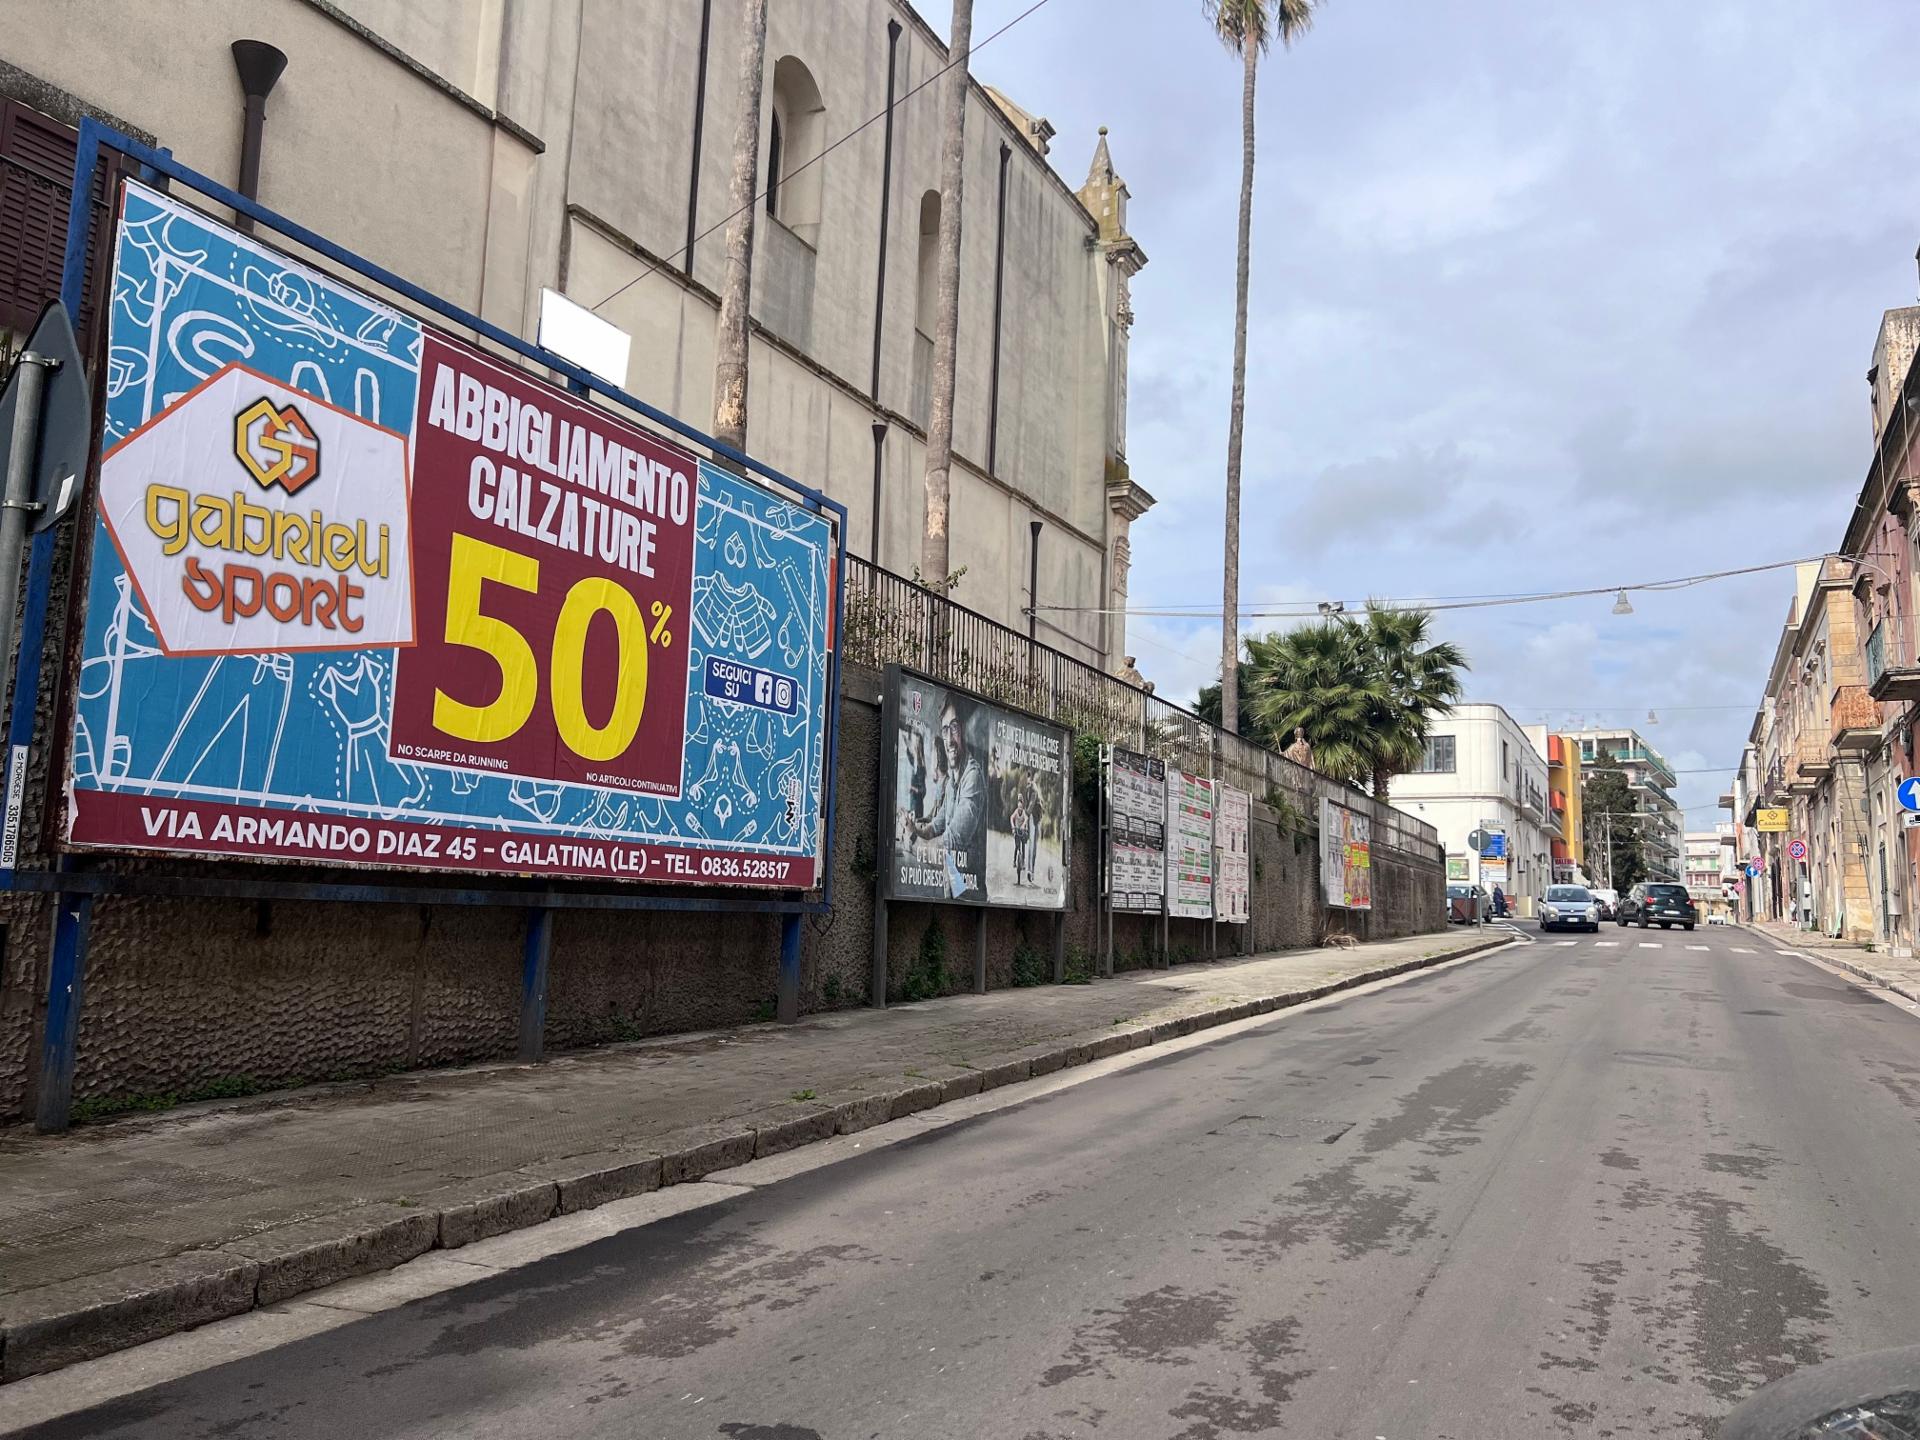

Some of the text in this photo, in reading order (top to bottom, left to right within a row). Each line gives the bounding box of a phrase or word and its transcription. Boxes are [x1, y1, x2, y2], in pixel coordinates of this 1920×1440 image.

[428, 363, 688, 525] ABBIGLIAMENTO
[468, 455, 656, 578] CALZATURE
[712, 661, 752, 686] SEGUICI
[725, 681, 740, 698] SU
[398, 743, 509, 770] NO SCARPE DA RUNNING
[586, 772, 678, 794] NO ARTICOLI CONTINUATIVI
[2, 804, 19, 863] 335.1786505
[141, 807, 202, 840] VIA
[210, 814, 371, 853] ARMANDO
[377, 830, 442, 858] DIAZ
[446, 836, 477, 861] 45
[501, 840, 607, 870] GALATINA
[610, 847, 647, 874] (LE)
[665, 853, 698, 876] TEL.
[701, 856, 790, 880] 0836.528517
[908, 865, 922, 885] PUÒ
[922, 868, 944, 887] CRESC
